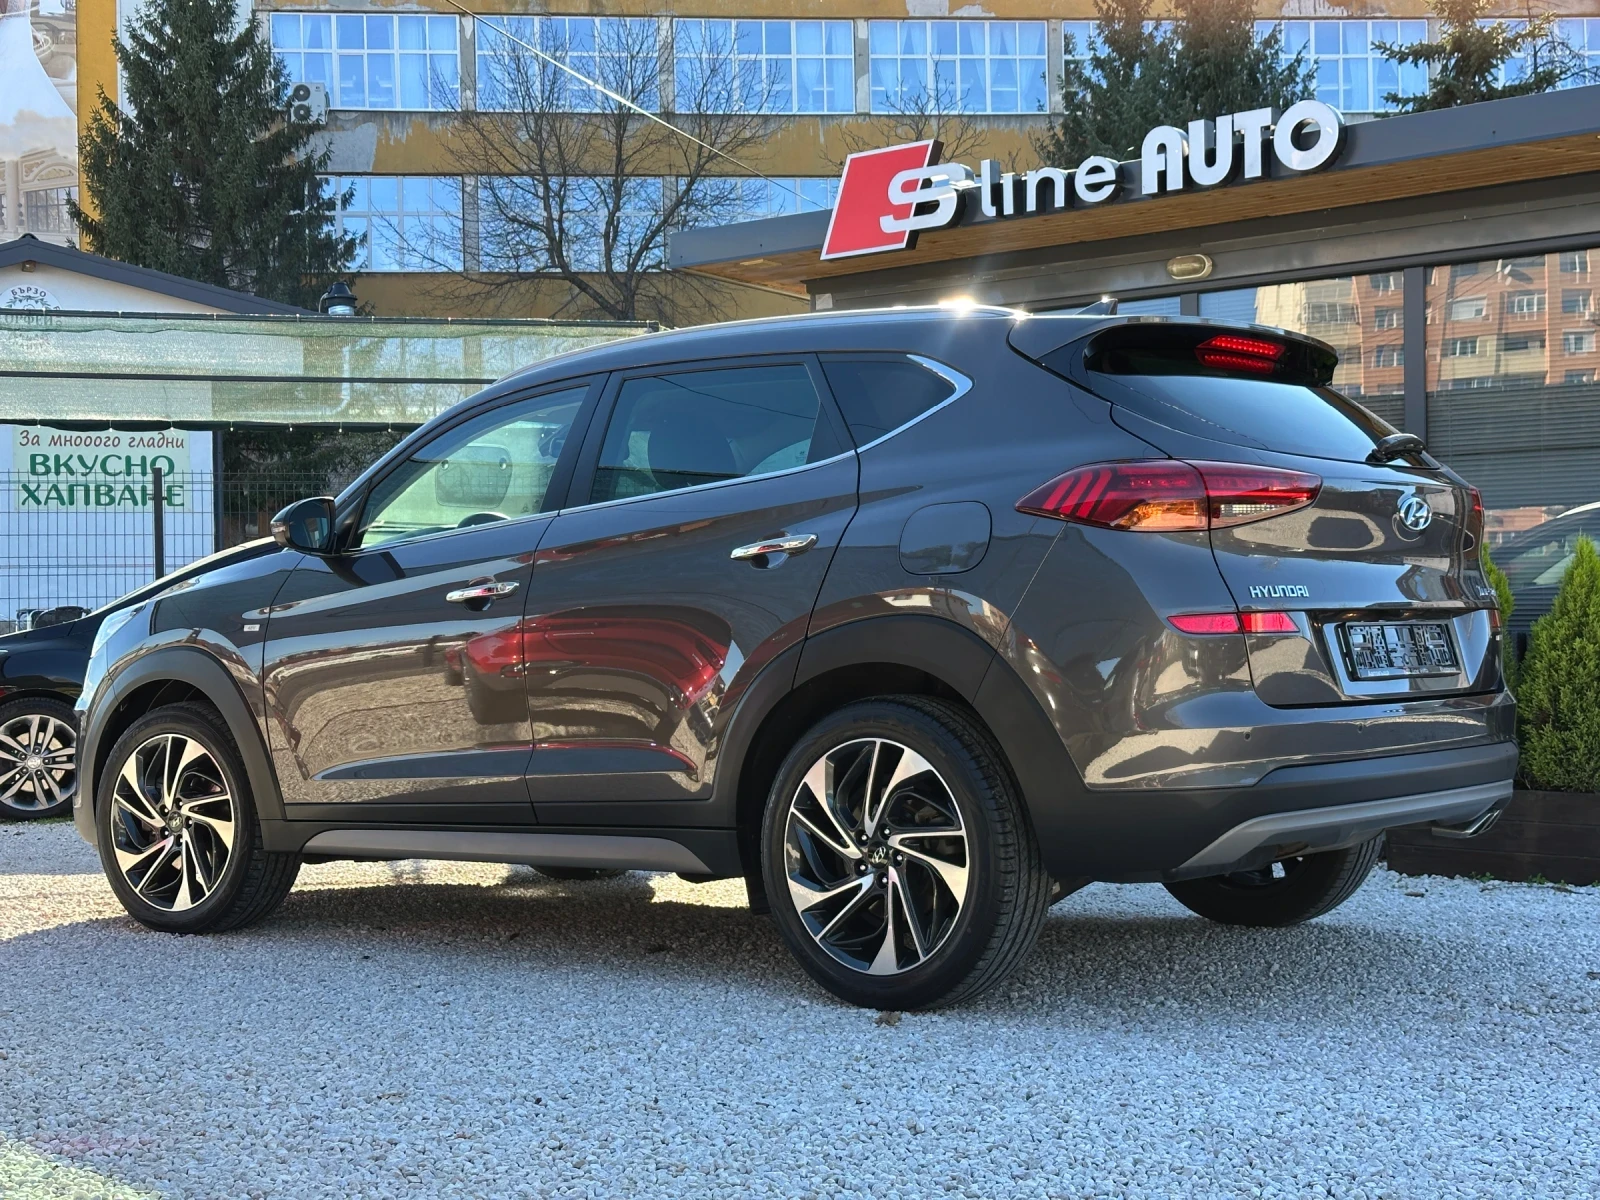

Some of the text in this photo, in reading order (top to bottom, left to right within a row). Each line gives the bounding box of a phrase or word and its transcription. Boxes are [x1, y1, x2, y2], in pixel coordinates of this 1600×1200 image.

[981, 155, 1122, 218] line
[1141, 99, 1344, 196] AUTO
[11, 286, 47, 298] БЪРЗО
[19, 429, 185, 449] За мнооого гладни
[29, 453, 176, 477] ВКУСНО
[1248, 585, 1310, 598] HYUNDAI
